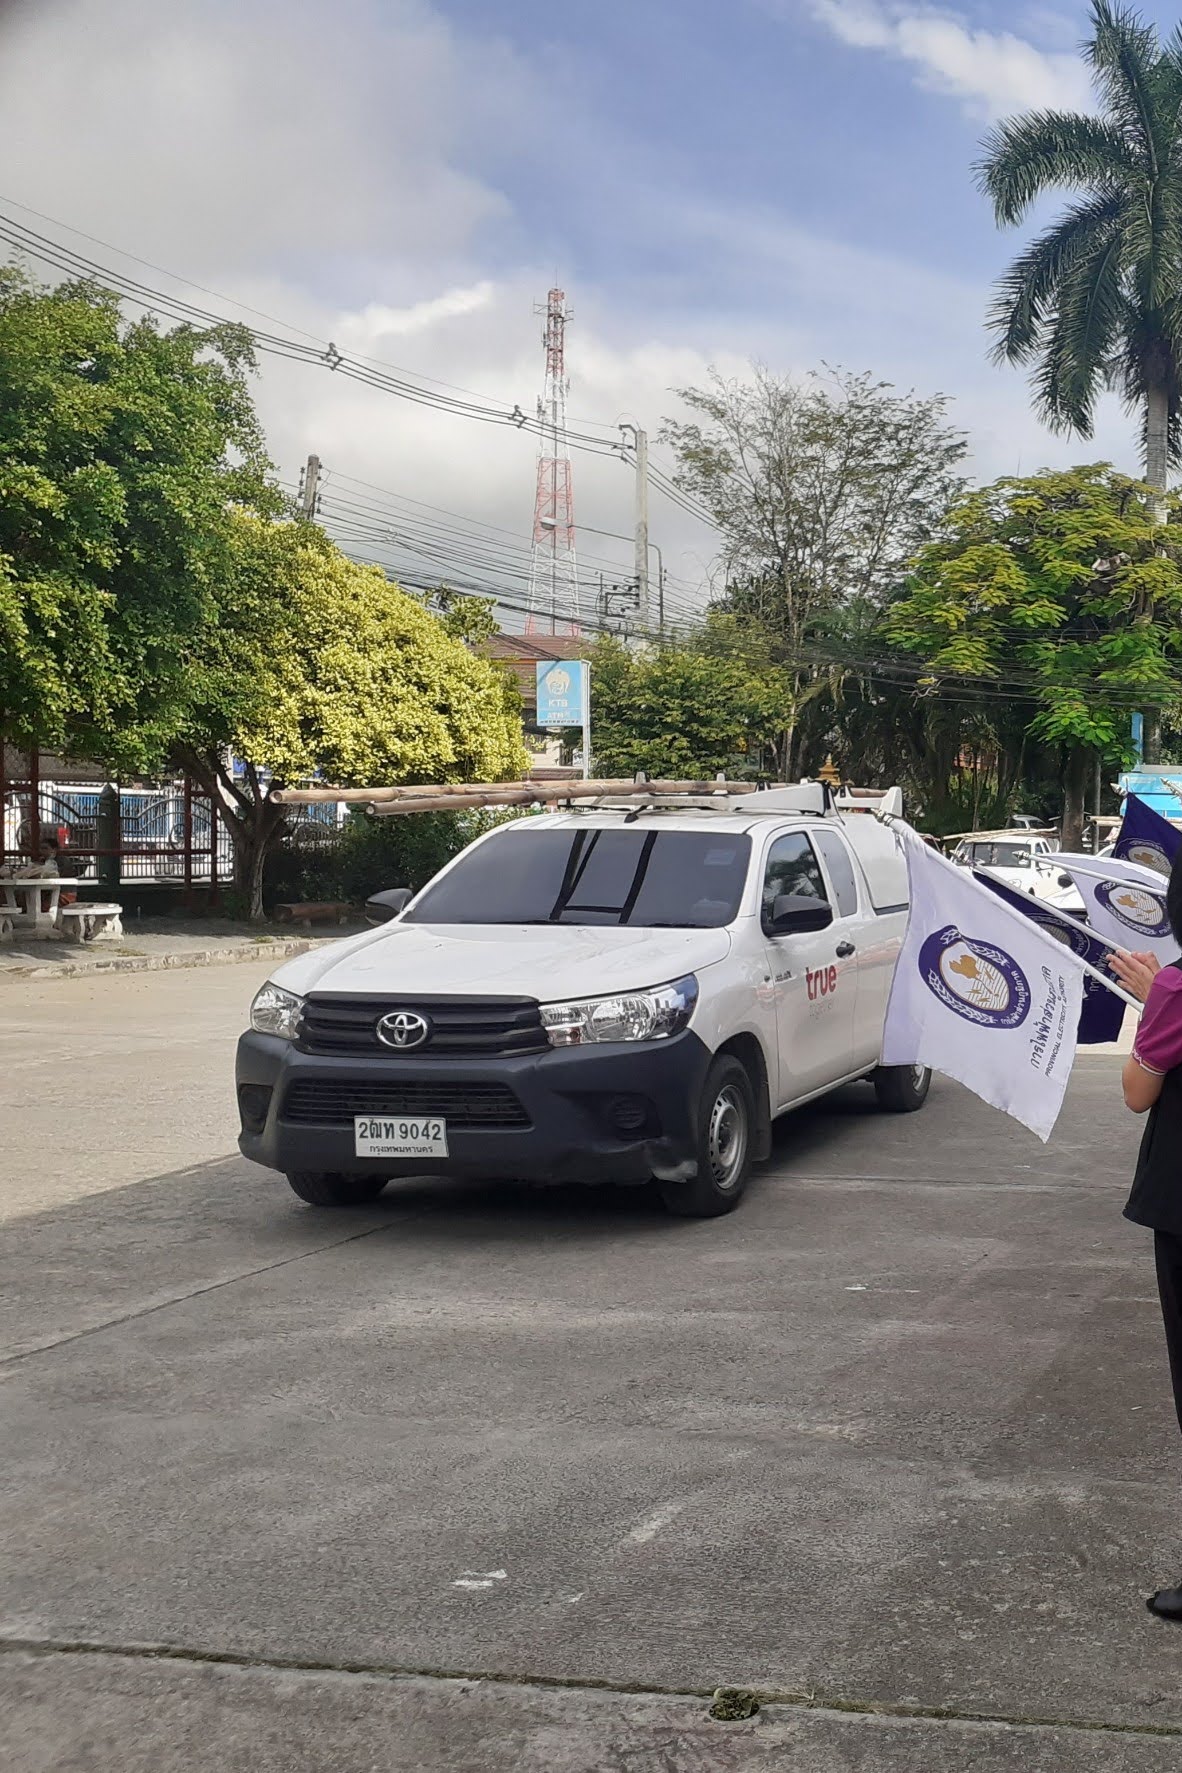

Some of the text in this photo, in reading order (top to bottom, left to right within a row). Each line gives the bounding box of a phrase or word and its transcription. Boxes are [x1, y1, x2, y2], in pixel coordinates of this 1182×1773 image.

[805, 965, 837, 1001] true
[399, 1122, 442, 1140] 9042
[369, 1145, 433, 1155] กรุงเทพมหานคร
